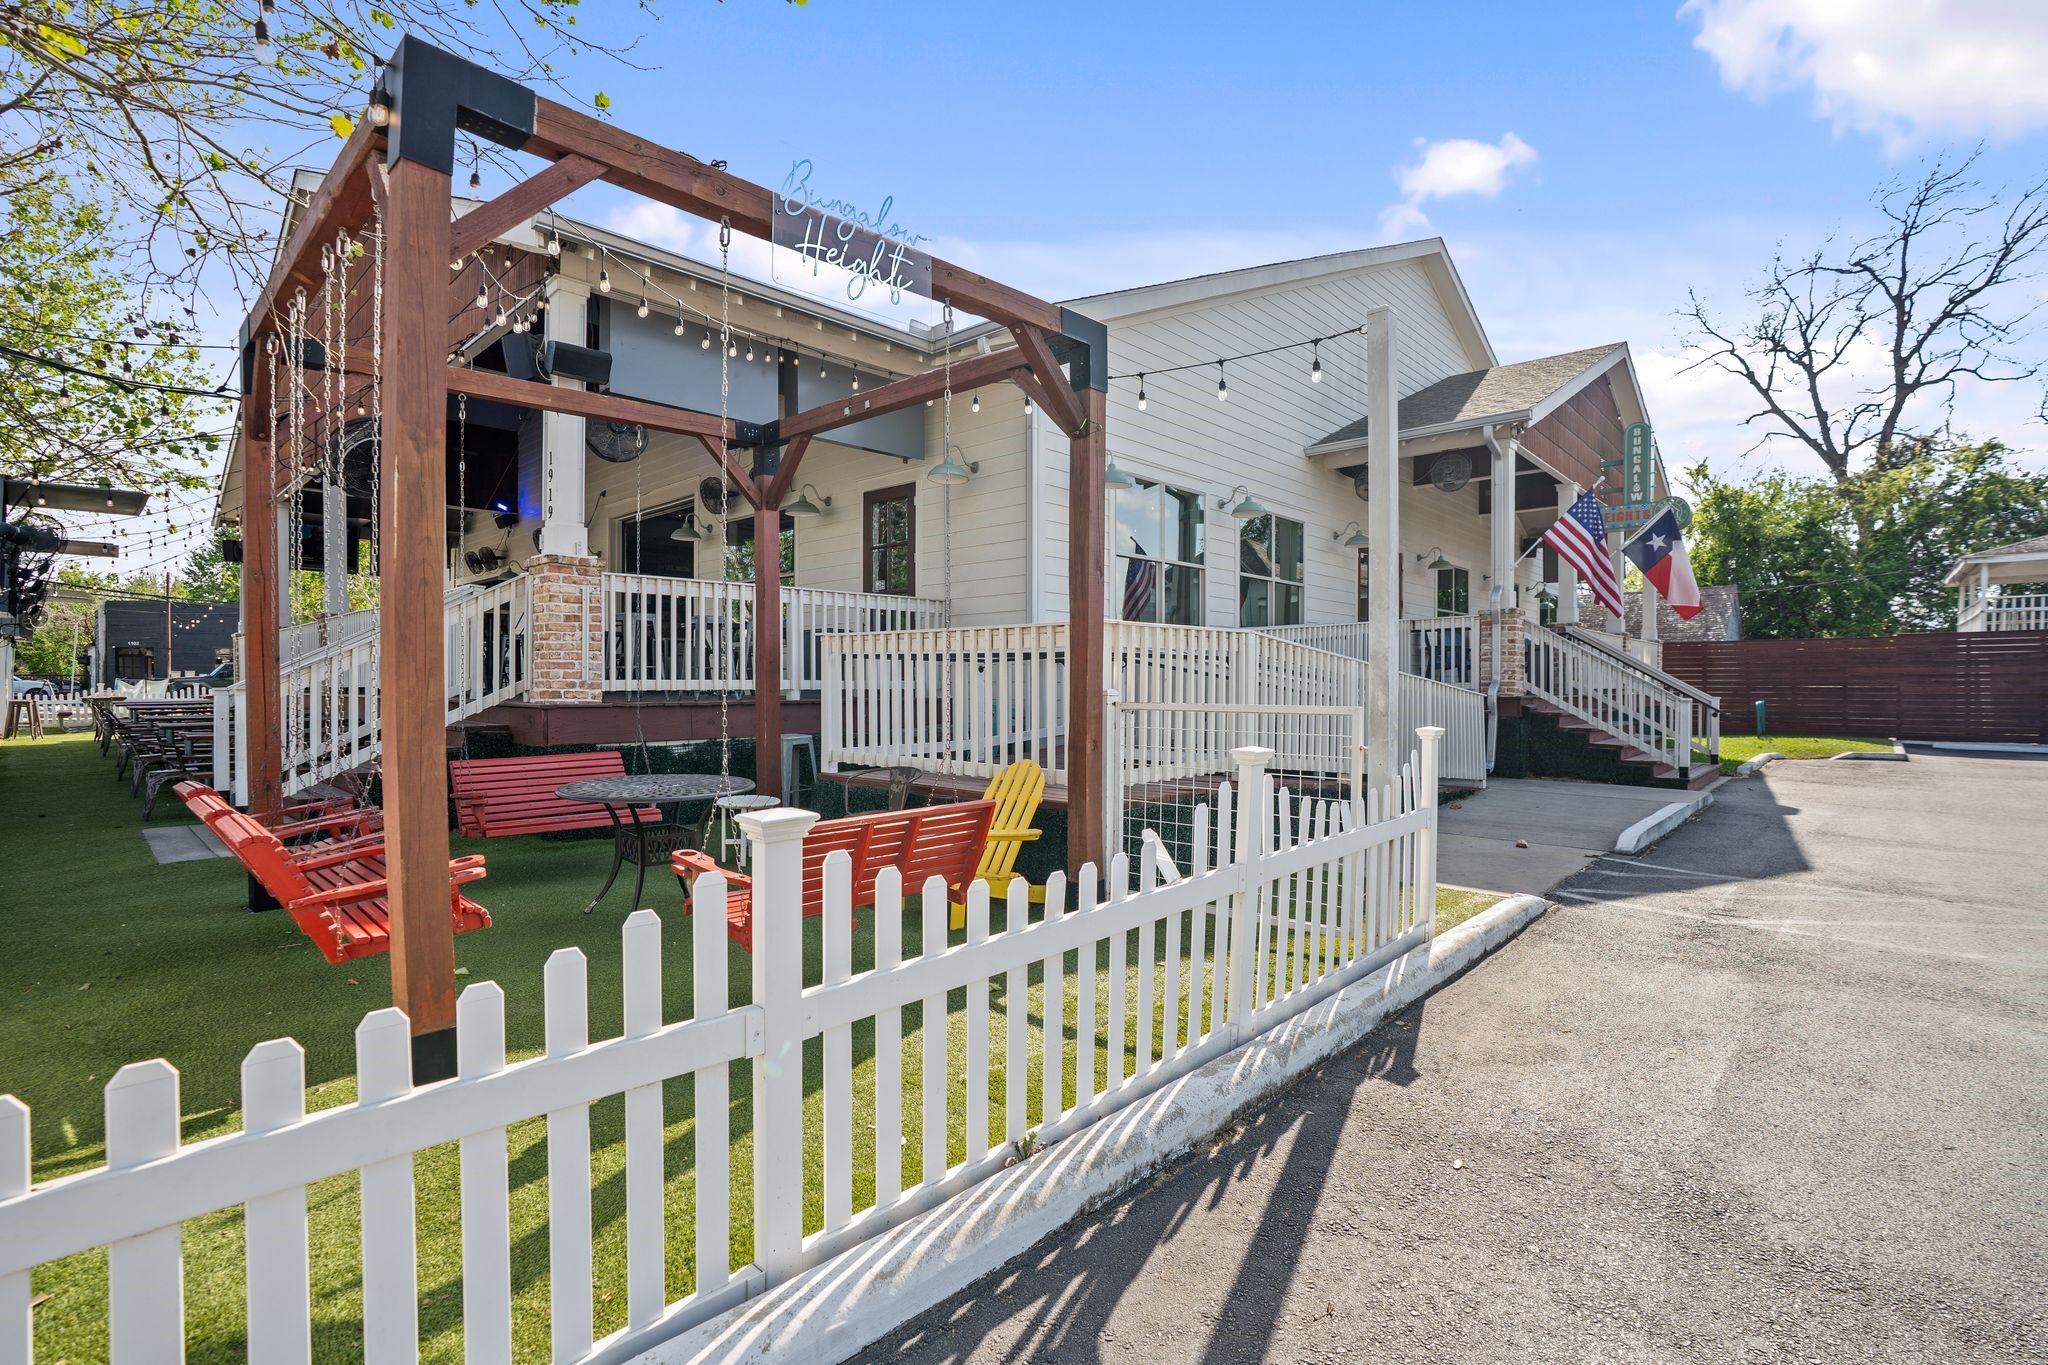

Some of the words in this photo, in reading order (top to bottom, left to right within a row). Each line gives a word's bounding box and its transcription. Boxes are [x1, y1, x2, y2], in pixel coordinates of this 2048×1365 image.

[779, 159, 932, 246] Bungalow
[795, 215, 914, 305] Heights
[1630, 427, 1643, 501] BUNGALOW
[1603, 509, 1650, 523] EIGHTS
